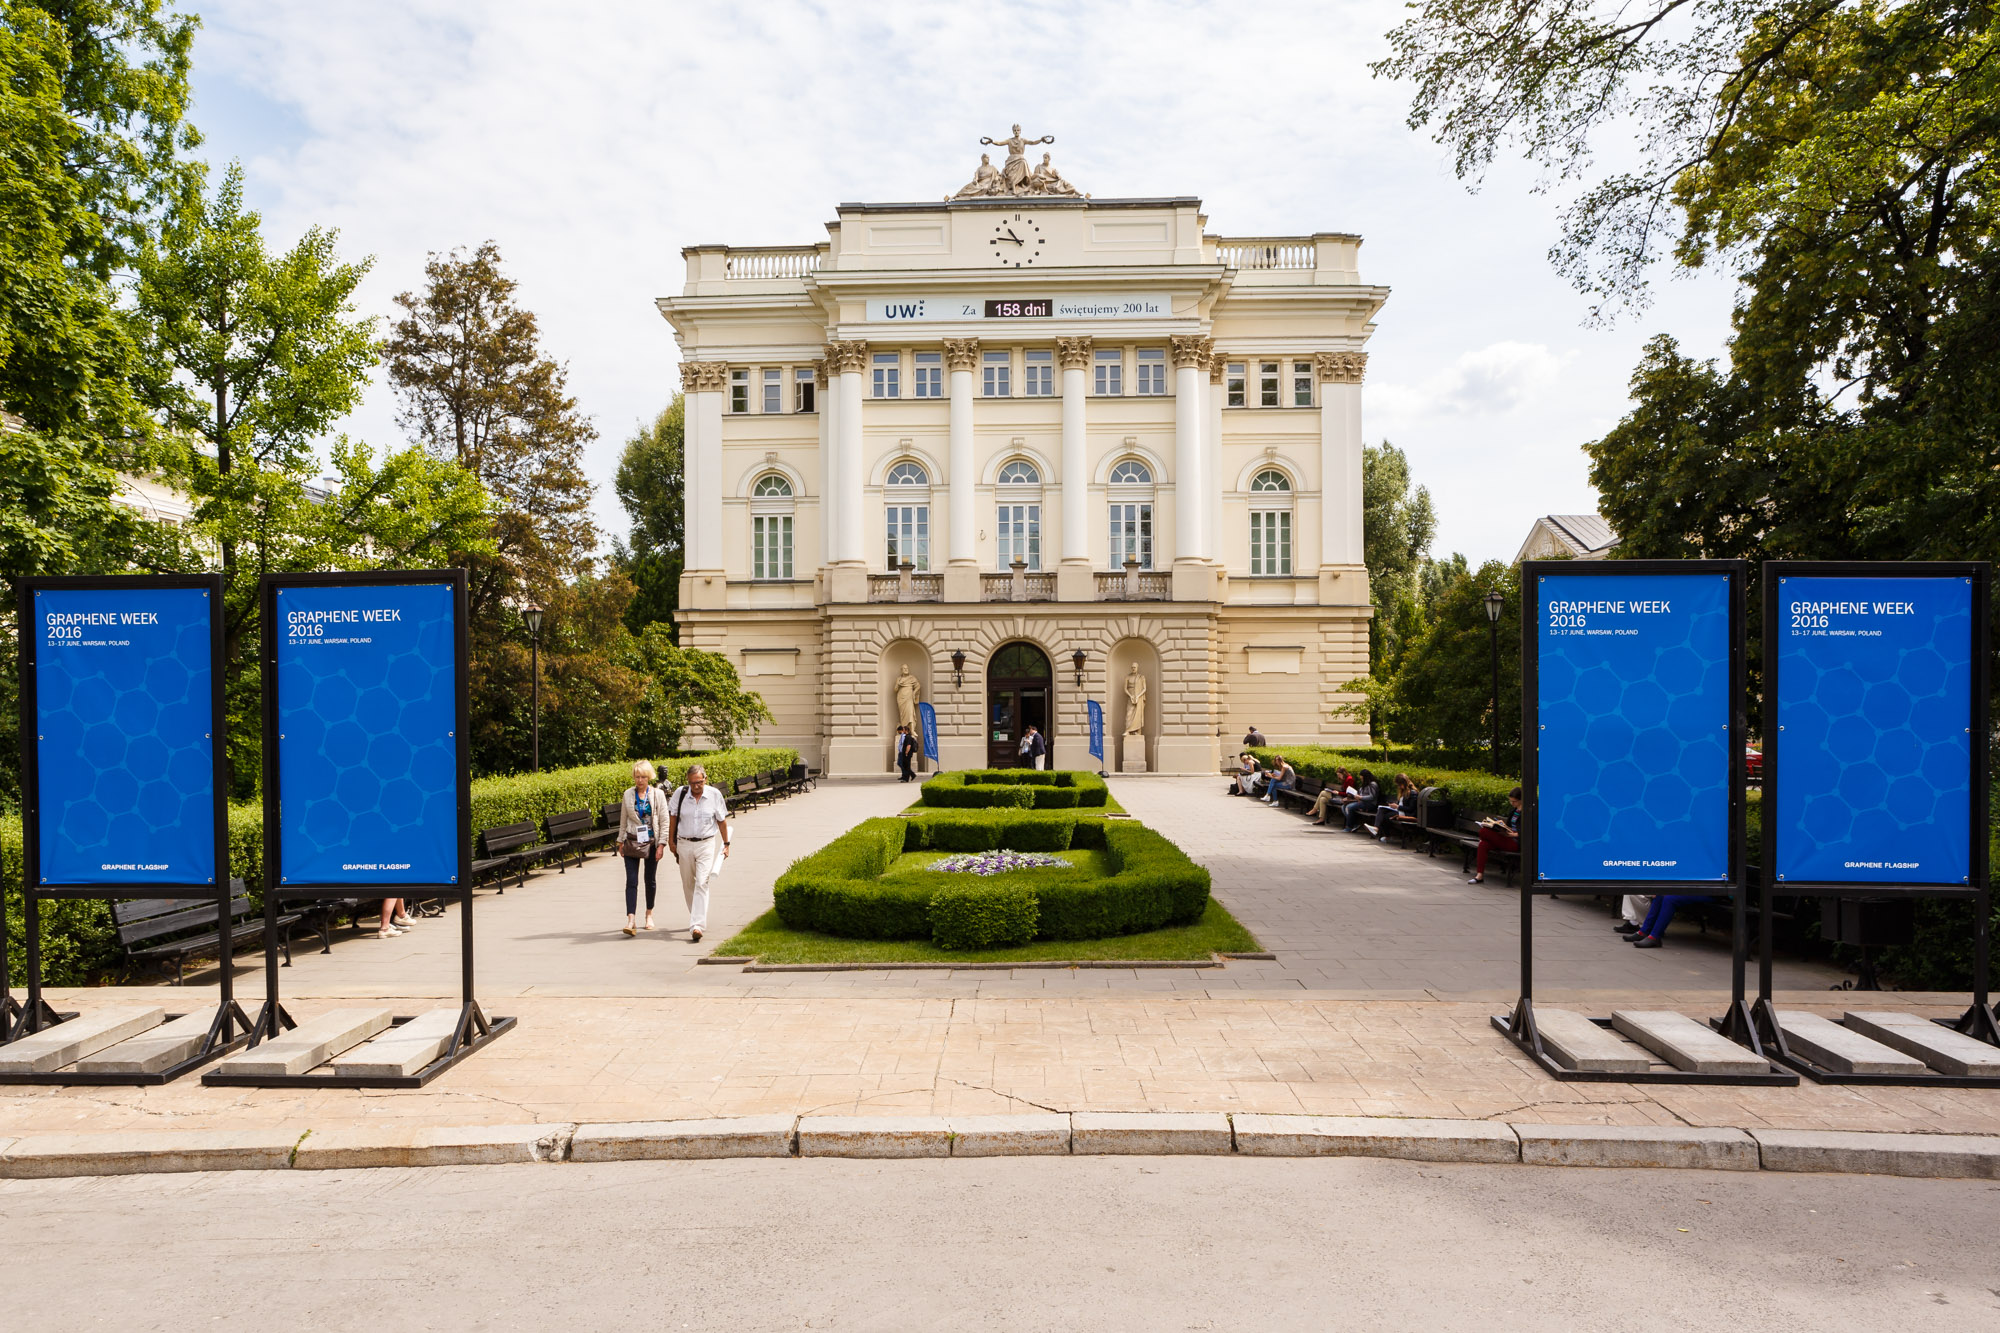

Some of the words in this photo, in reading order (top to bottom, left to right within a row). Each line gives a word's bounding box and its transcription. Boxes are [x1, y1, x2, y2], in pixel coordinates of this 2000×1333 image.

[962, 305, 976, 315] Za
[996, 303, 1020, 317] 158
[1025, 302, 1045, 317] dni
[1059, 304, 1120, 317] świętujemy
[1123, 303, 1142, 313] 200
[1145, 302, 1159, 313] lat
[1549, 600, 1625, 614] GRAPHENE
[1630, 600, 1670, 614] WEEK
[1791, 601, 1868, 617] GRAPHENE
[1873, 601, 1914, 615] WEEK
[47, 612, 117, 626] GRAPHENE
[120, 612, 158, 625] WEEK
[288, 610, 358, 624] GRAPHENE
[363, 609, 400, 622] WEEK
[1550, 614, 1586, 628] 2016
[1792, 614, 1828, 628] 2016
[48, 626, 81, 639] 2016
[289, 623, 323, 637] 2016
[1845, 861, 1882, 869] GRAPHENE
